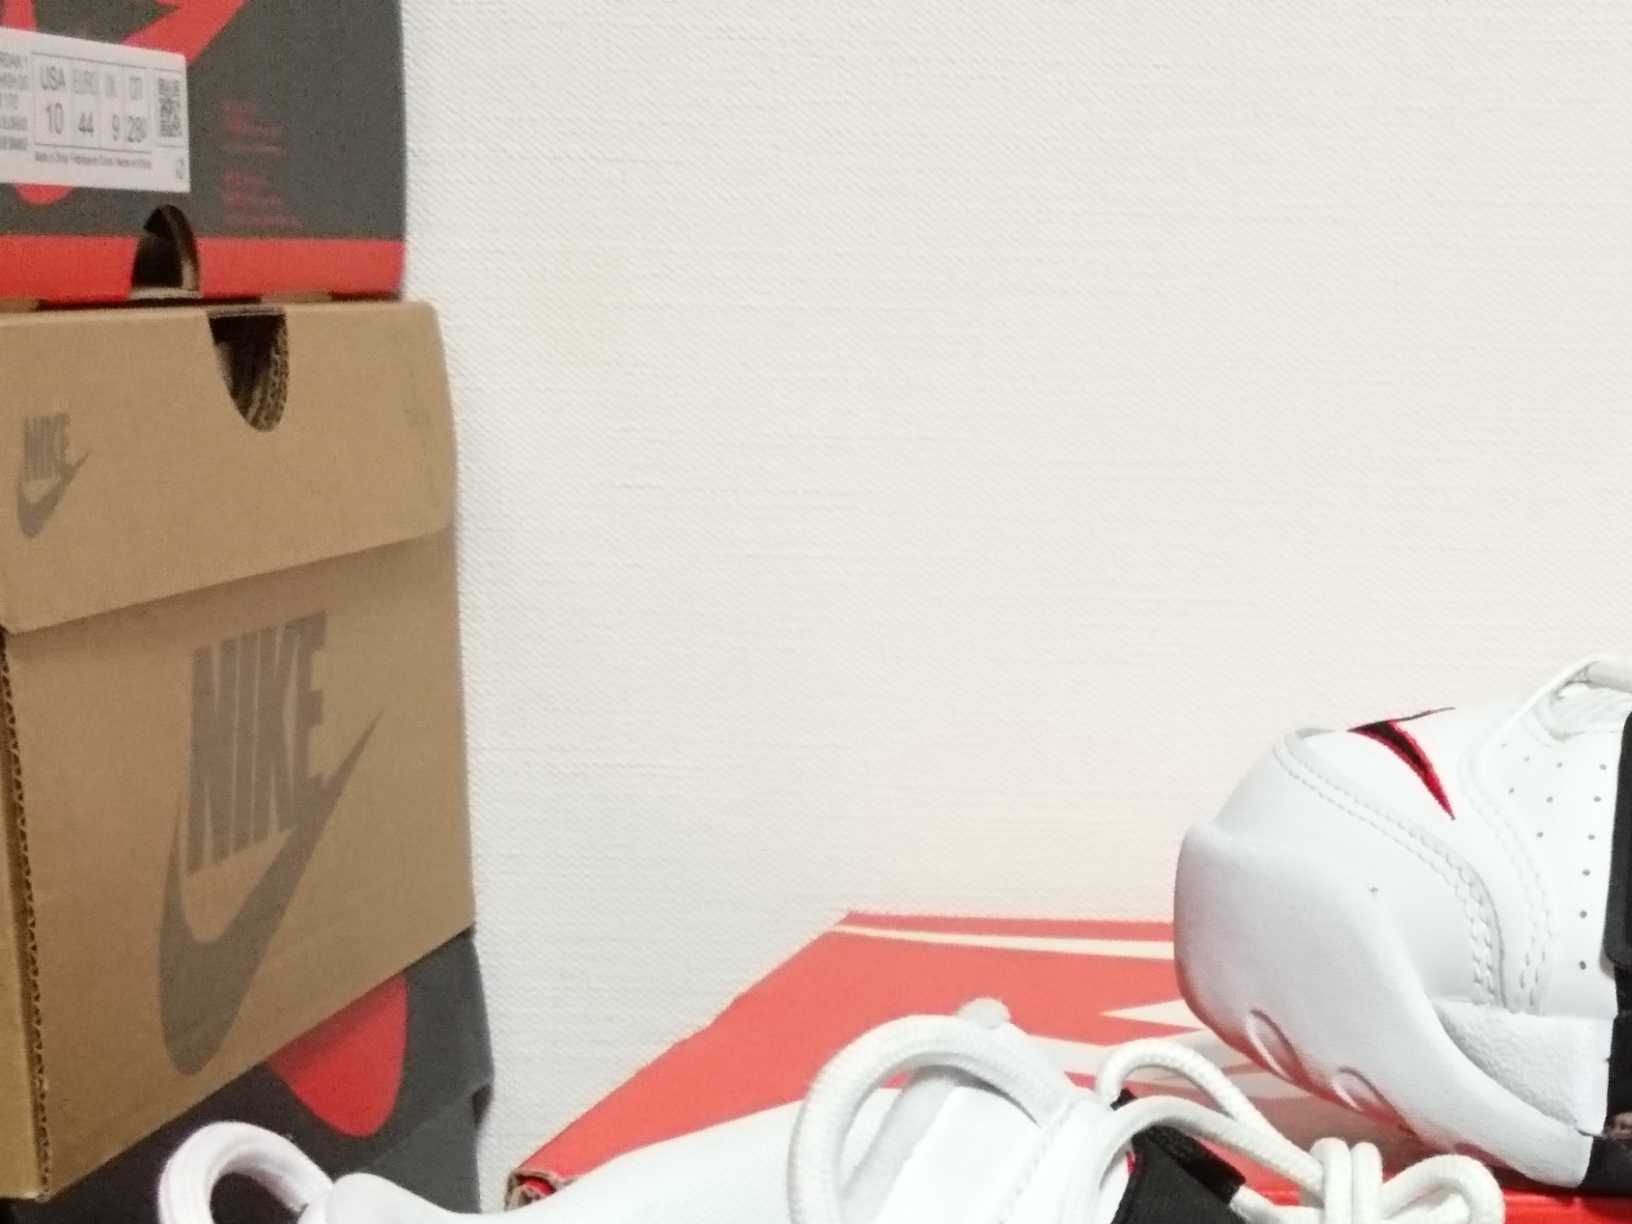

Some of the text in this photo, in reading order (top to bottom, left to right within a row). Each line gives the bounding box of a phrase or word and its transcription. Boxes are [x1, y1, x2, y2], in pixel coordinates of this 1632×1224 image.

[39, 65, 66, 92] USA
[45, 102, 65, 135] 10
[77, 111, 95, 137] 44
[186, 611, 327, 878] NIKE
